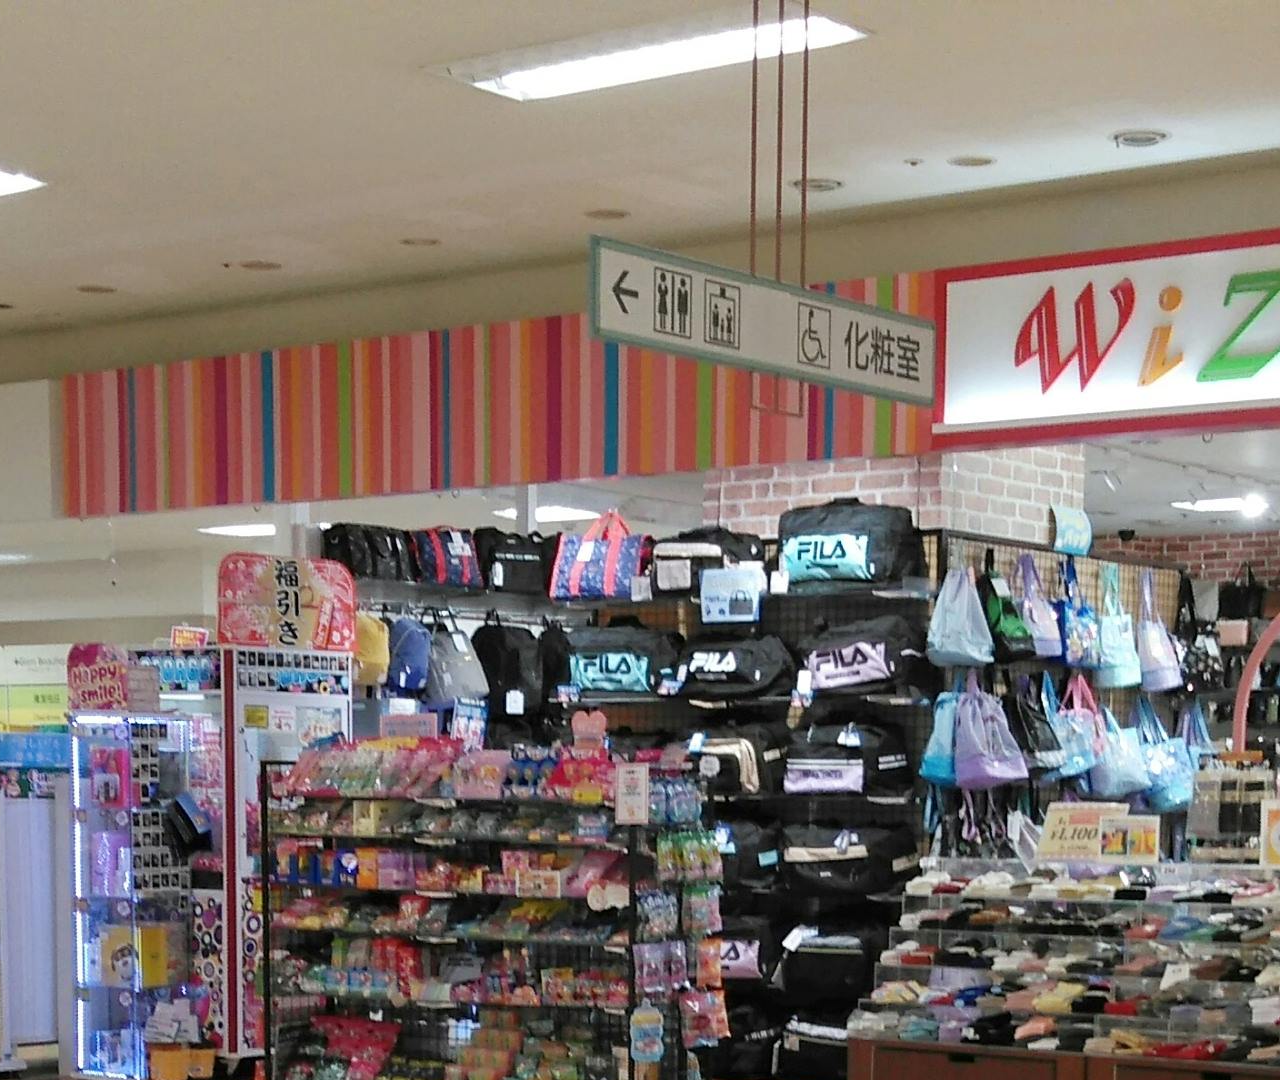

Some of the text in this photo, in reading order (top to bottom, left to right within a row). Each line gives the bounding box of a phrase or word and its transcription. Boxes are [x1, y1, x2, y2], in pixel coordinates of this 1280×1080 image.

[843, 324, 922, 384] 化粧室
[797, 541, 847, 561] FILA
[274, 559, 301, 646] 福引き
[582, 654, 632, 675] FILA
[688, 650, 738, 673] FILA
[814, 647, 869, 674] FILA
[71, 665, 118, 685] Happy
[80, 685, 121, 703] smile!
